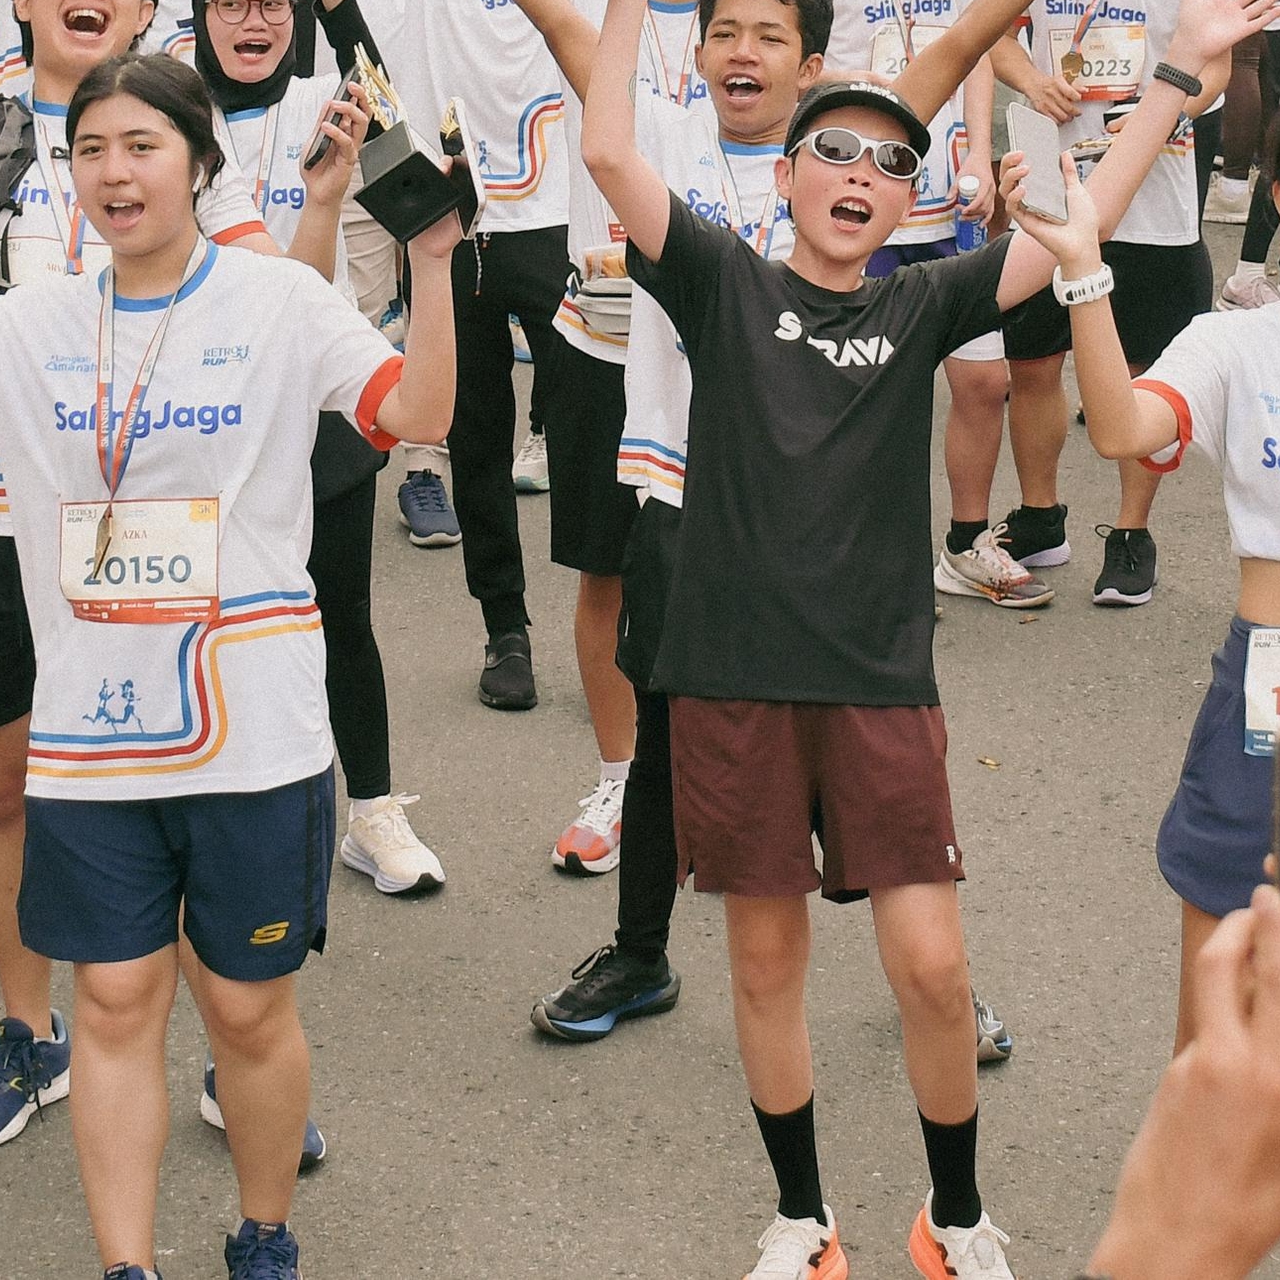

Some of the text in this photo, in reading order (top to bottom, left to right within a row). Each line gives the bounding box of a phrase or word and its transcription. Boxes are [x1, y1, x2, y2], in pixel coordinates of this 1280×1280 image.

[201, 357, 227, 367] RUN
[54, 399, 243, 439] SalngJaga
[122, 529, 148, 540] AZKA
[83, 554, 192, 586] 20150
